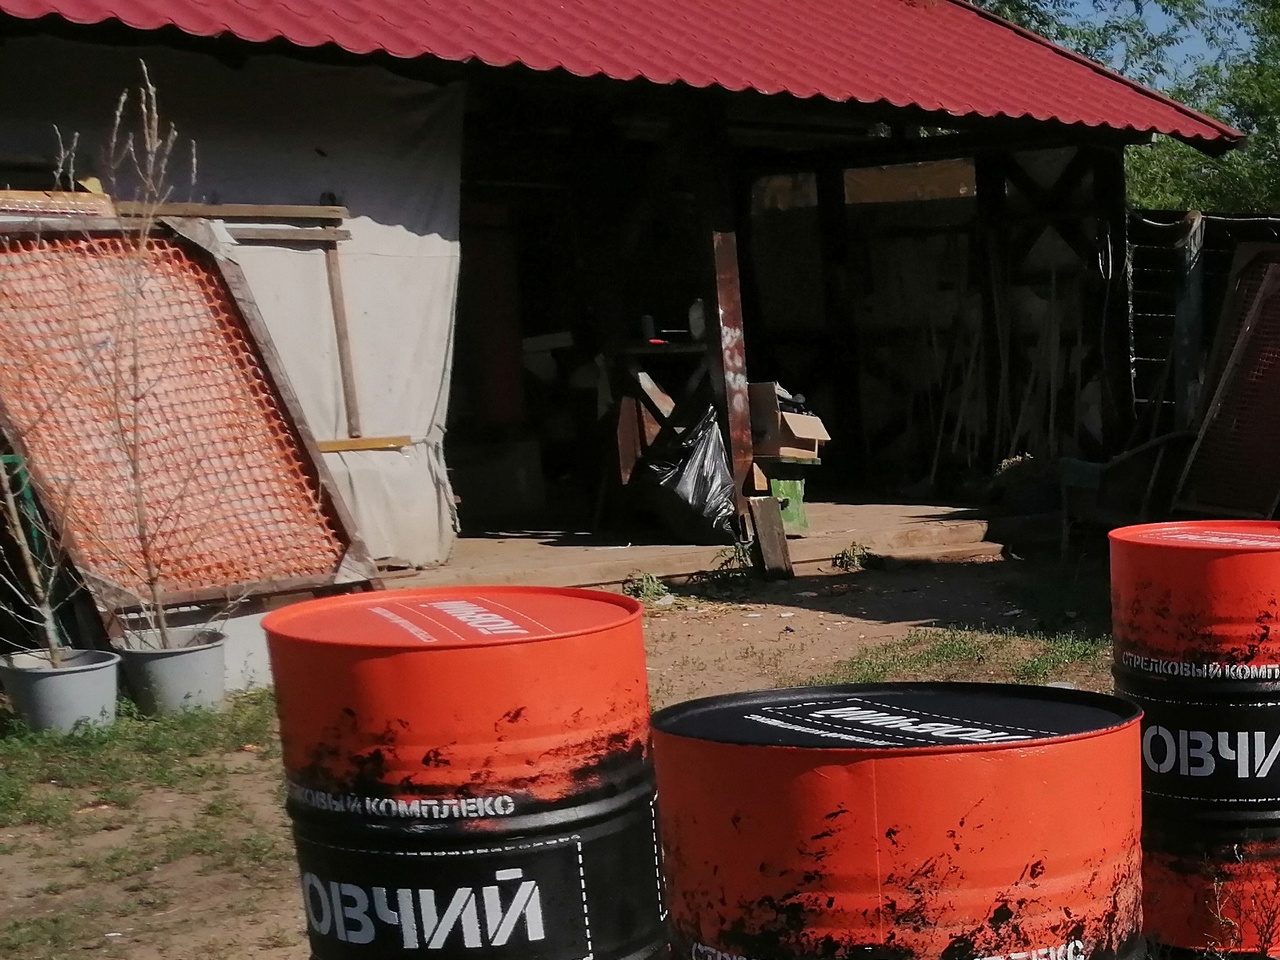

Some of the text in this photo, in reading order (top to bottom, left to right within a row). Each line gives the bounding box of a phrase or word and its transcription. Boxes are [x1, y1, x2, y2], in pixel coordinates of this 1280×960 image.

[1122, 651, 1222, 680] СТРЕЛКОВЫЙ
[365, 793, 516, 819] КОМПЛЕКС
[302, 868, 546, 949] ОВЧИЙ
